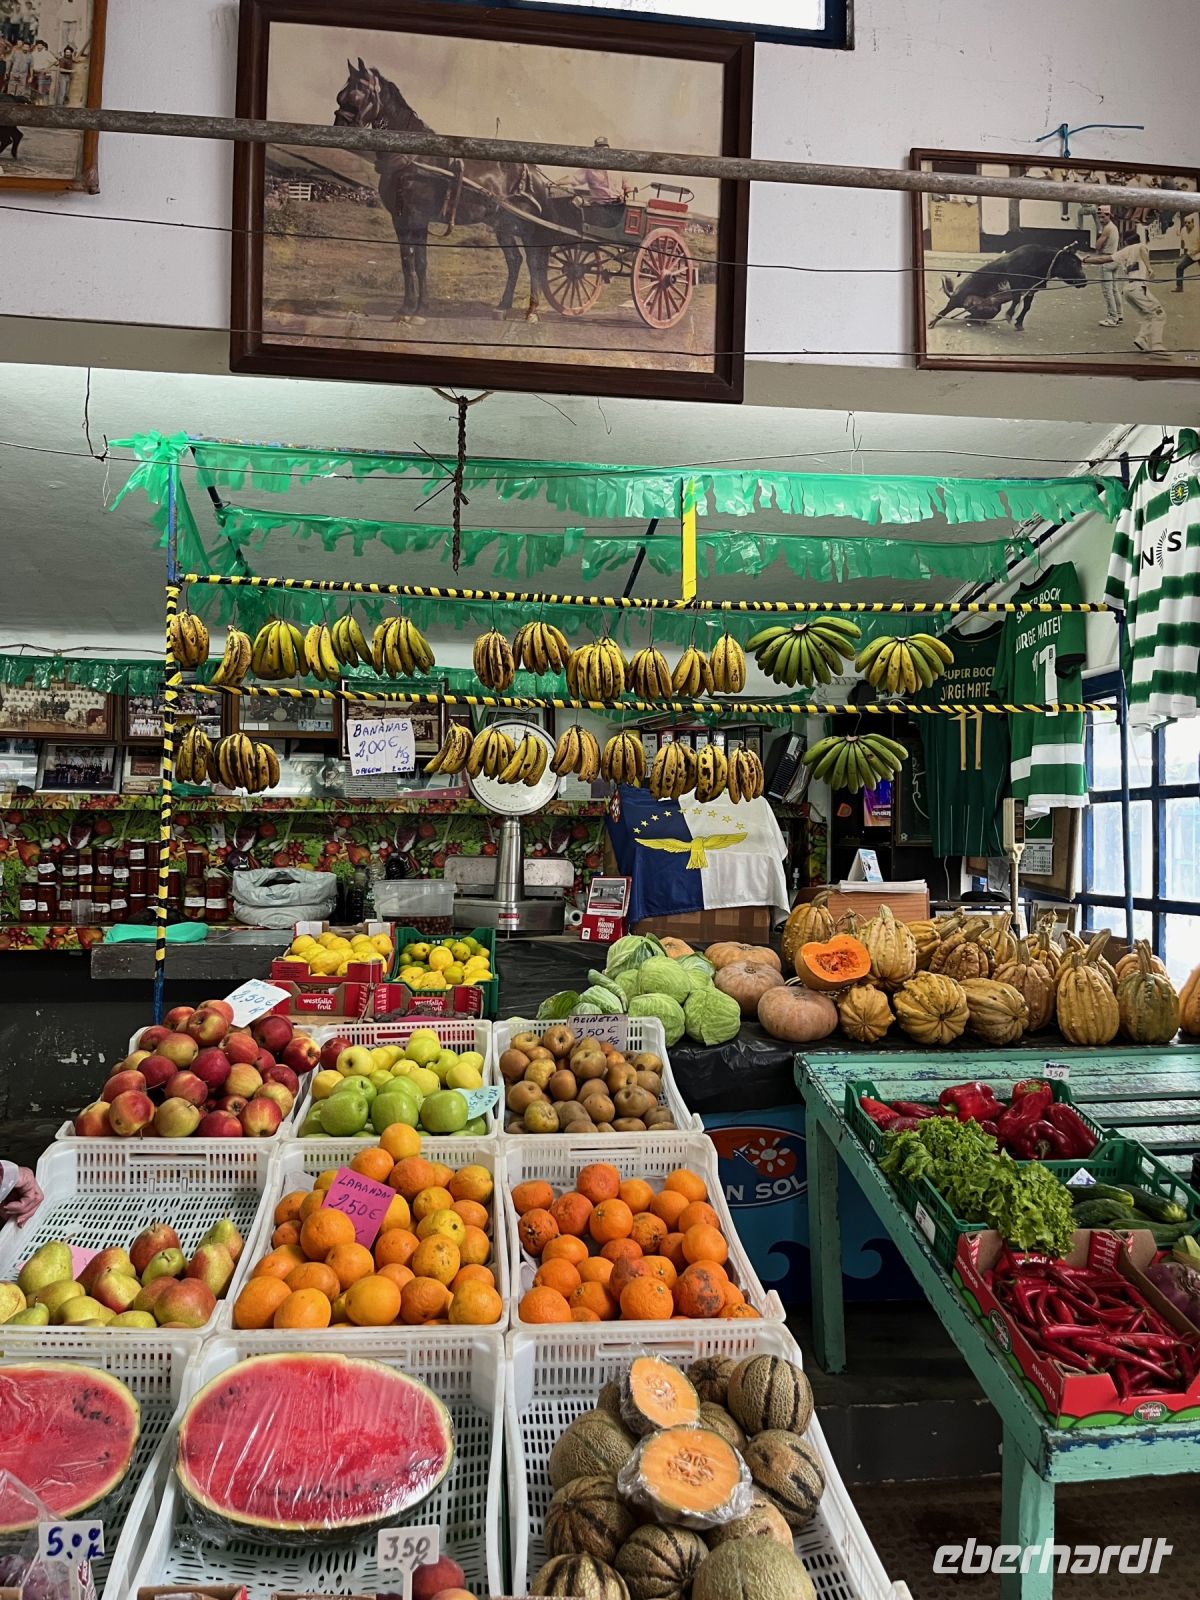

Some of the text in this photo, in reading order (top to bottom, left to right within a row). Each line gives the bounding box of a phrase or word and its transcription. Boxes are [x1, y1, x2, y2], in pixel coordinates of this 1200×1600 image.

[1039, 587, 1061, 604] BOCK
[944, 668, 970, 681] SUPER
[353, 722, 408, 738] BANANAS
[948, 710, 983, 771] 11
[755, 1175, 808, 1199] SOL
